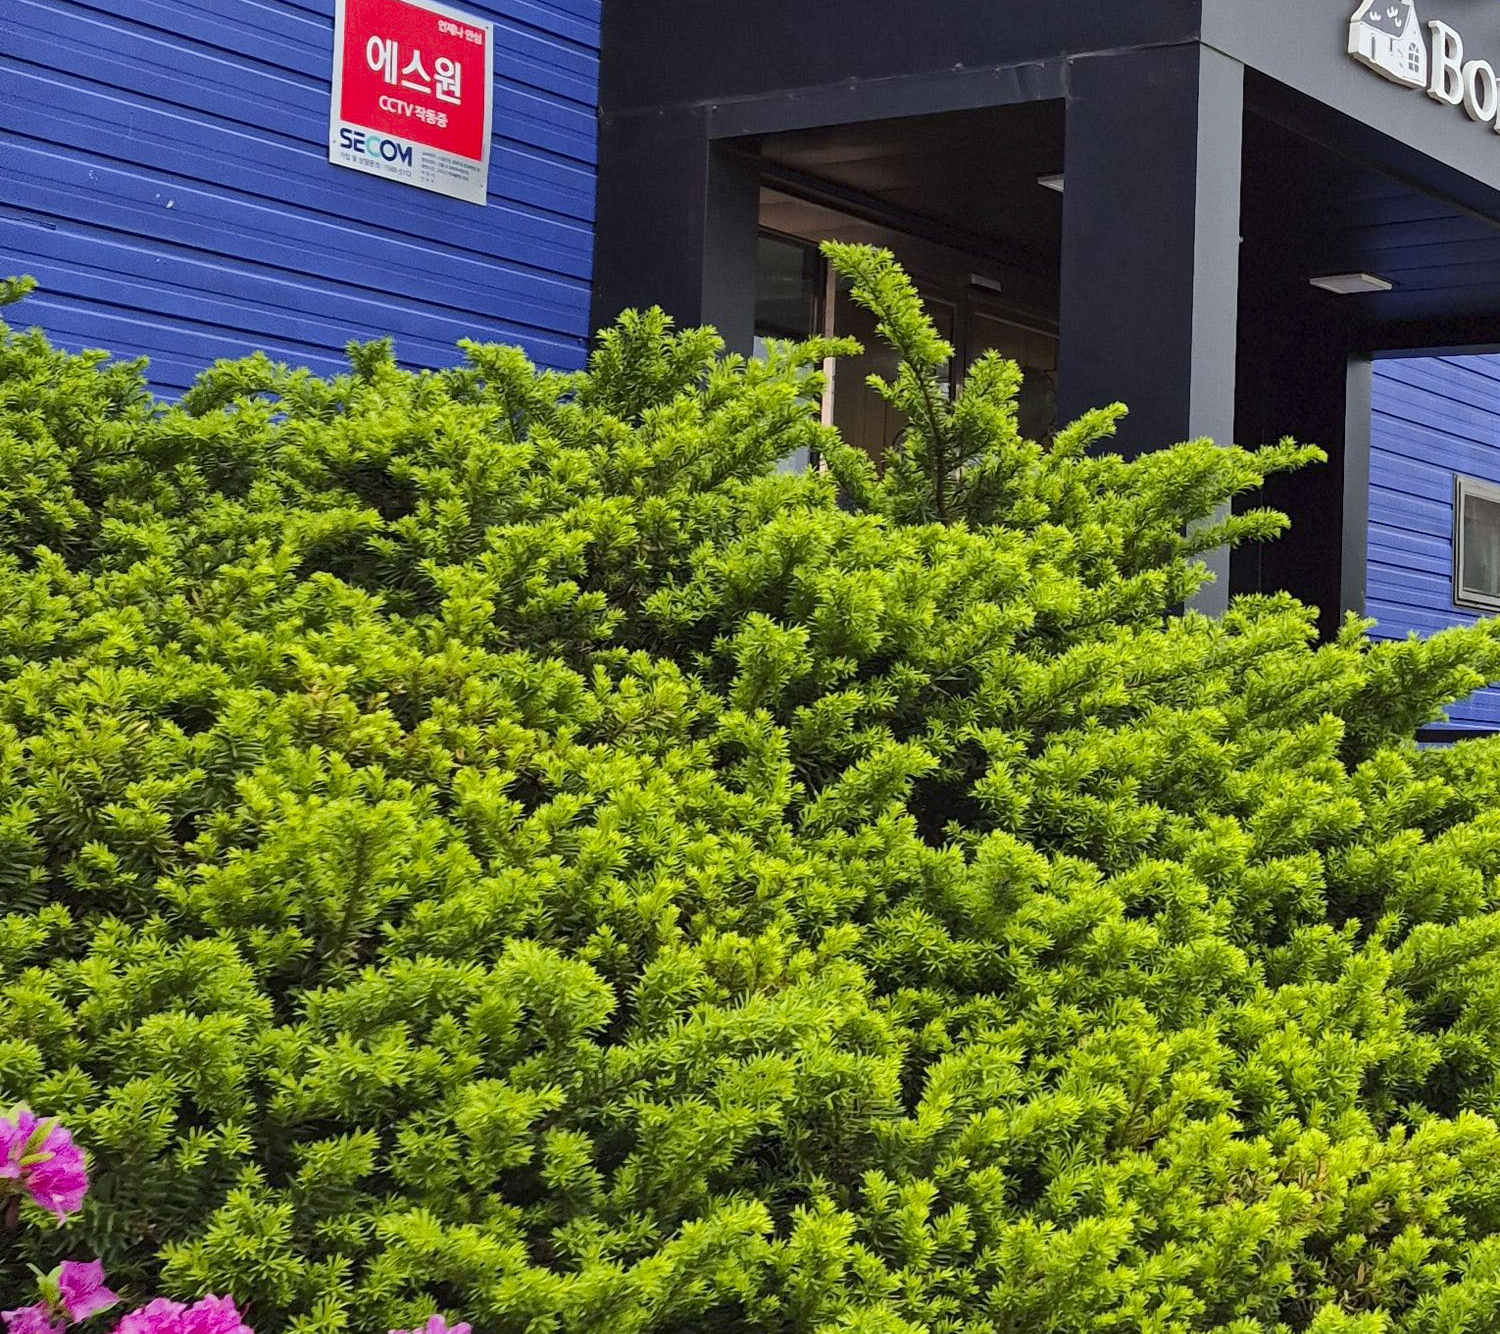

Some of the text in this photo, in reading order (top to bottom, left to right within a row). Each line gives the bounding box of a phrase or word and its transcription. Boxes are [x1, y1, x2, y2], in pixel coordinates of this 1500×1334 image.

[366, 35, 462, 105] 에스원
[378, 94, 449, 129] CCTV 작동중
[340, 127, 413, 167] SECOM
